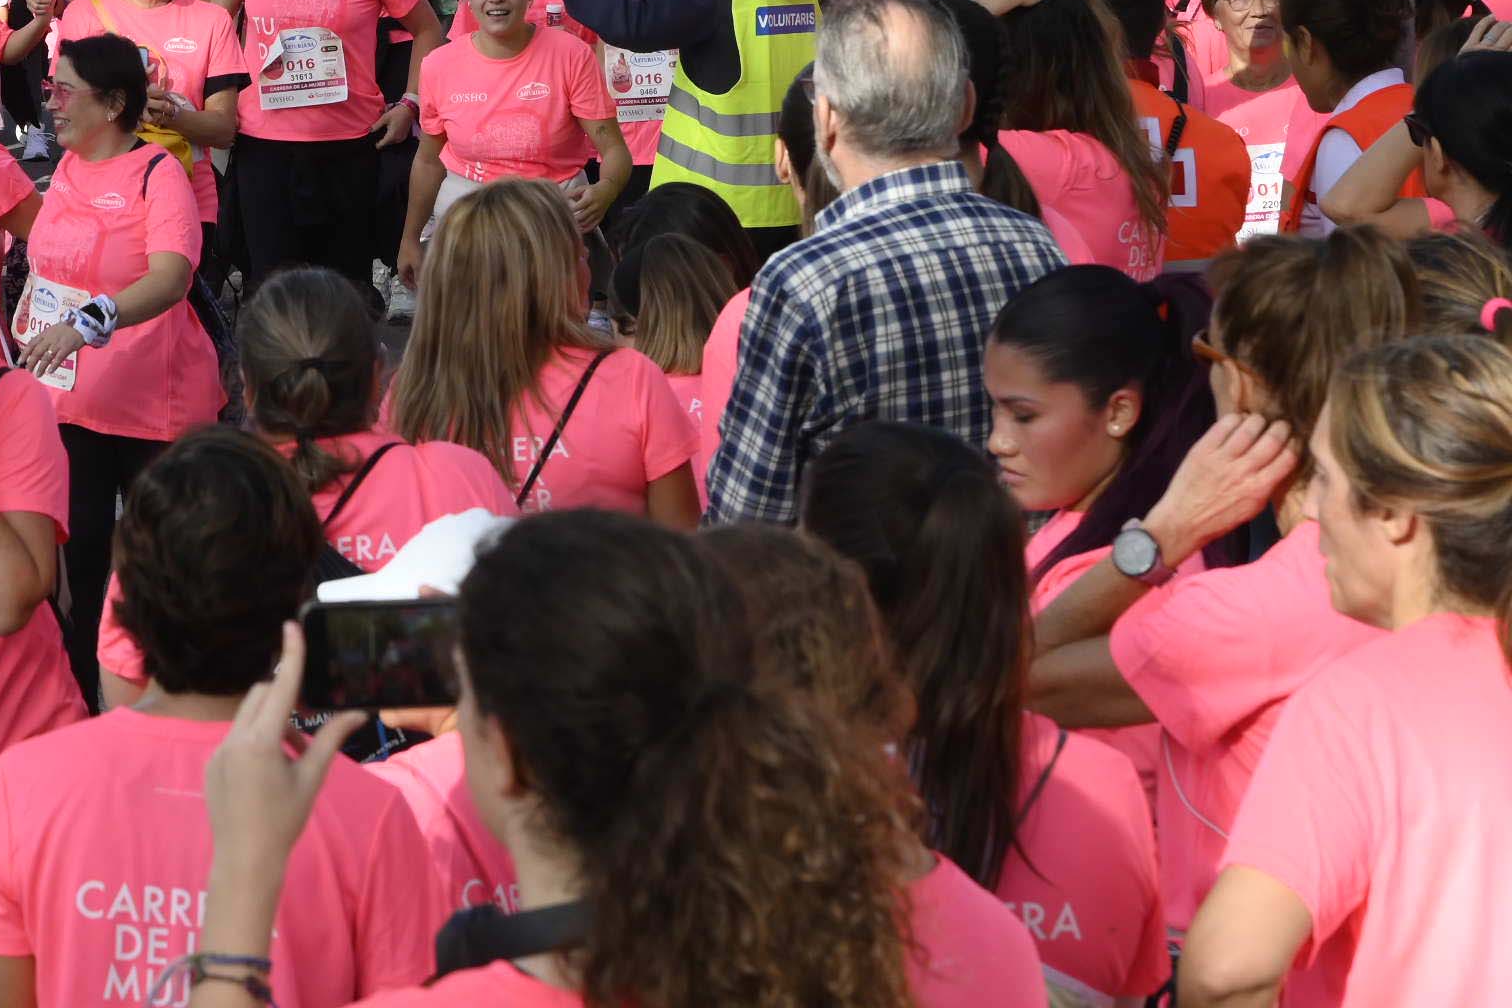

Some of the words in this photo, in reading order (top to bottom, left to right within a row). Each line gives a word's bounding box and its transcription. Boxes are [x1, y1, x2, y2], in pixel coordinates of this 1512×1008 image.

[253, 16, 275, 36] TU
[757, 10, 816, 29] VOLUNTARIS
[286, 58, 315, 71] 016
[635, 73, 662, 85] 016
[450, 91, 487, 104] OYSHO
[115, 923, 170, 966] DE
